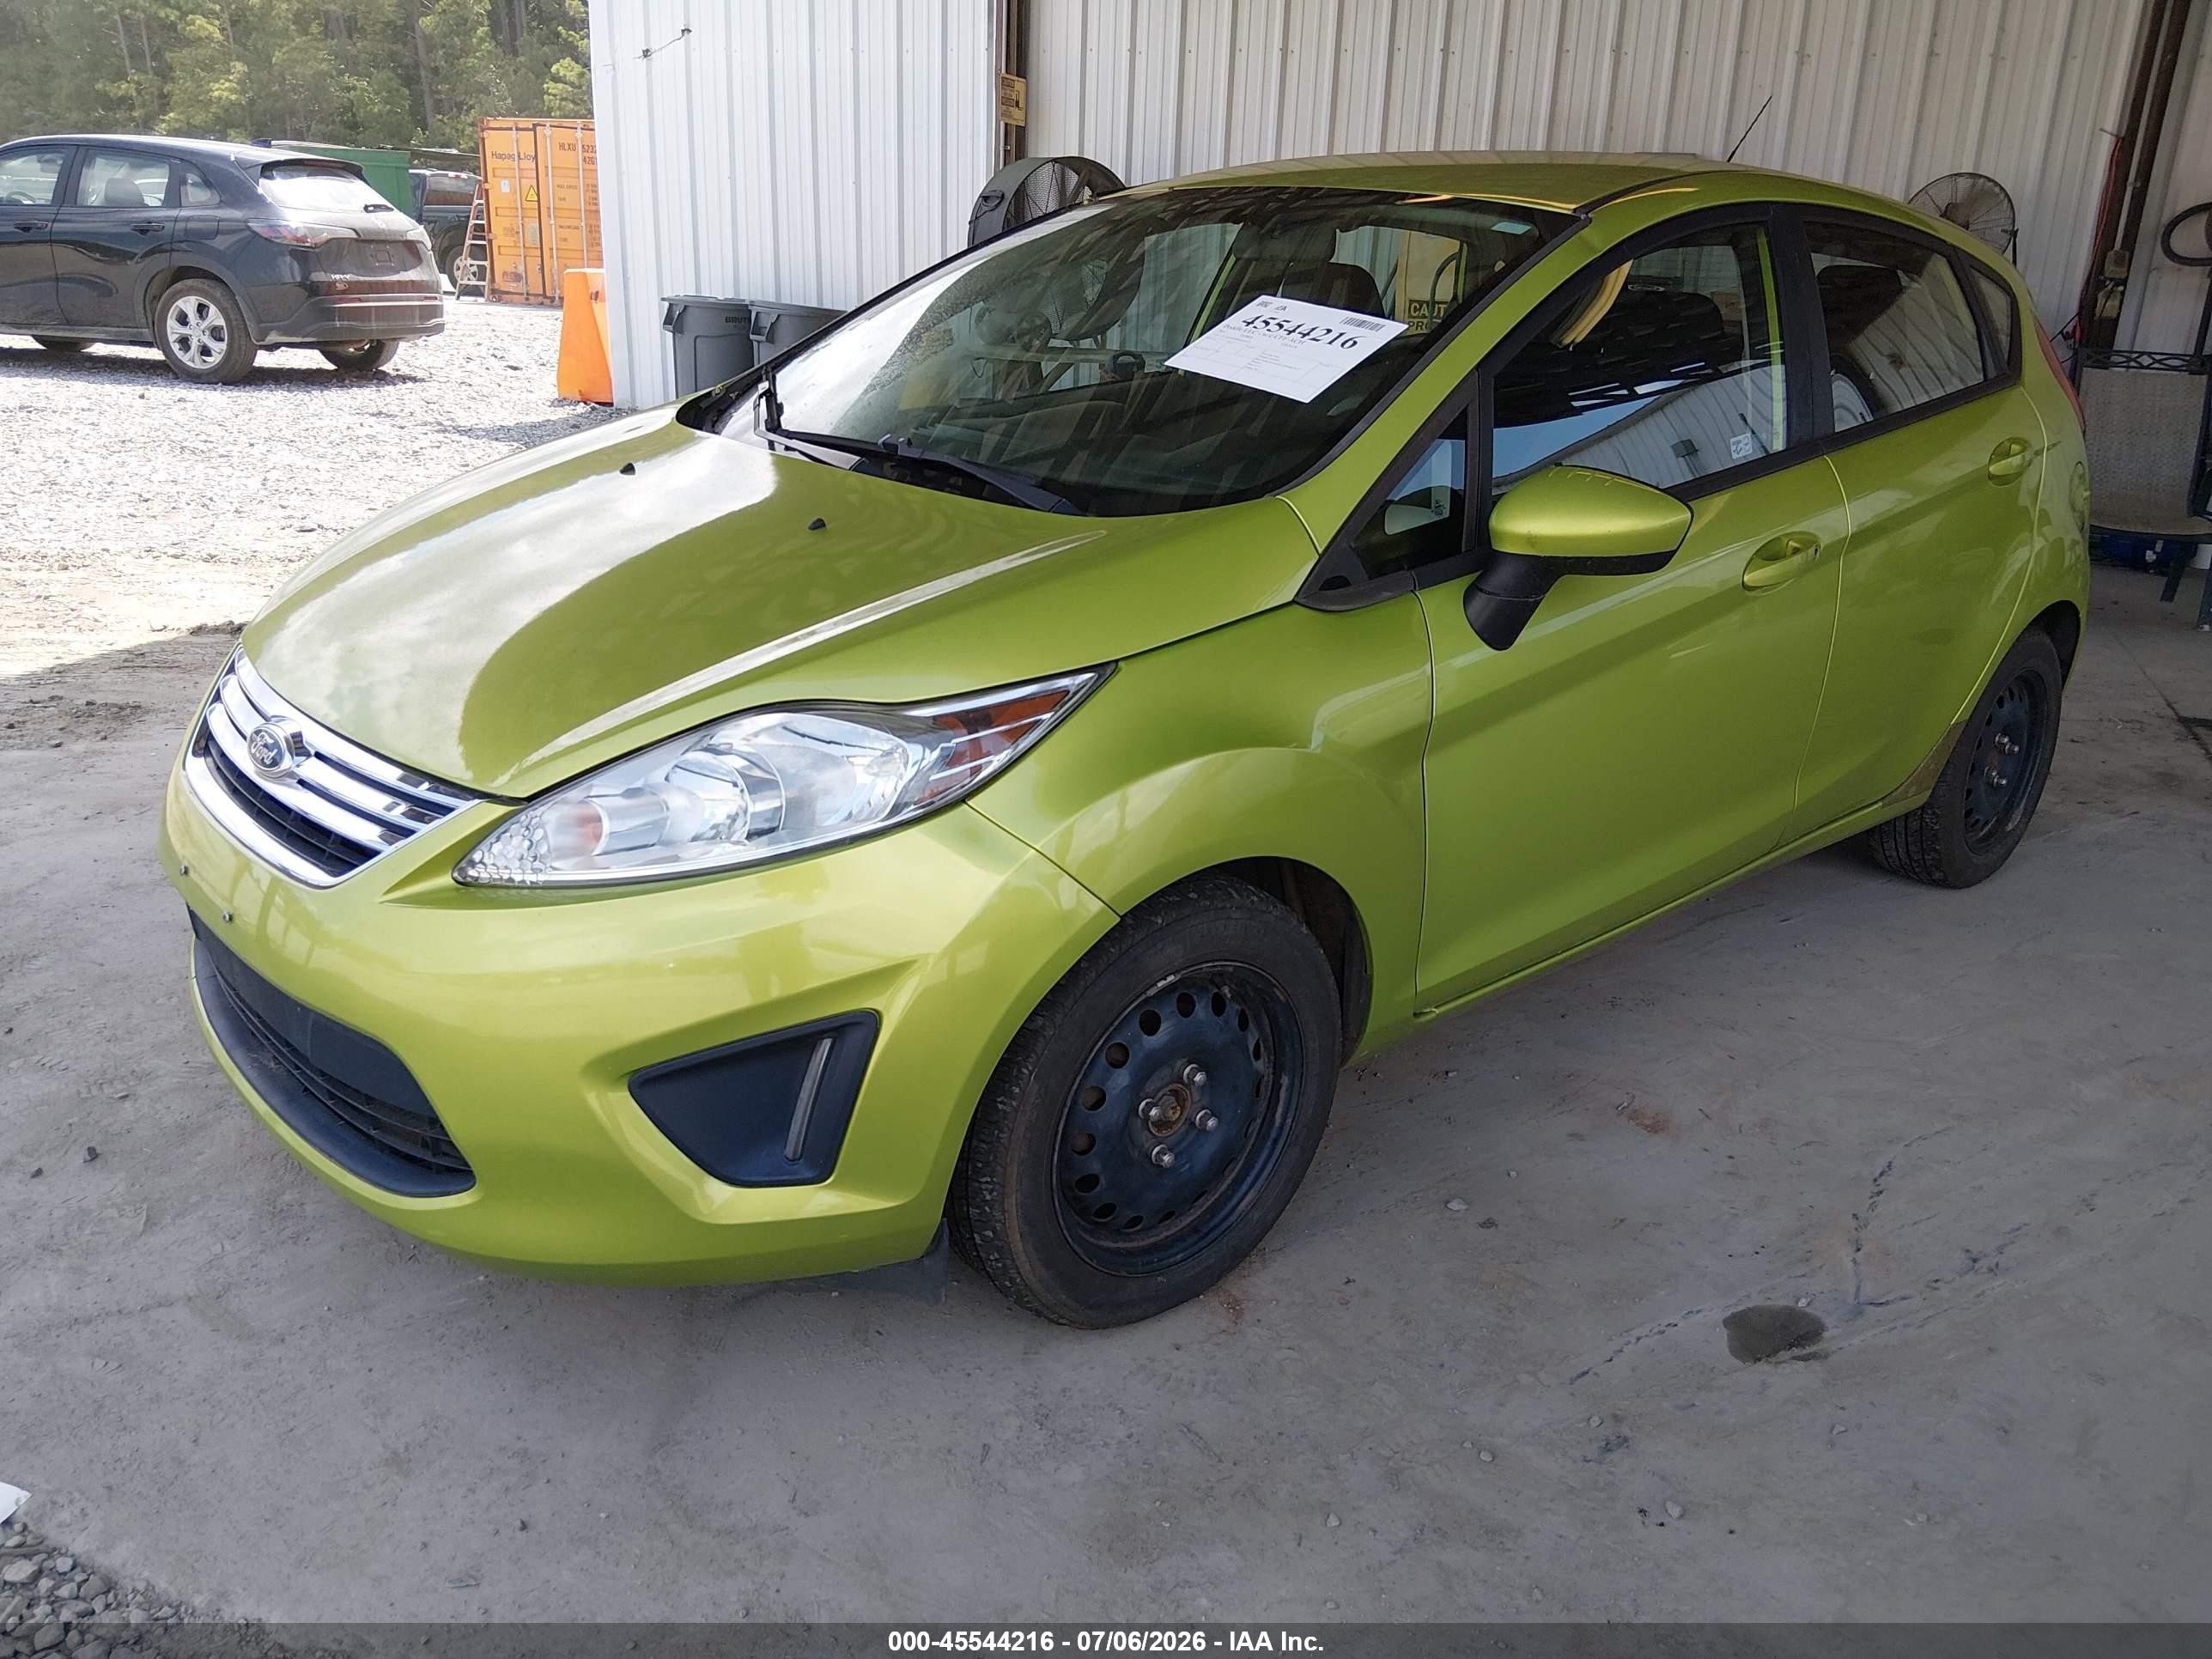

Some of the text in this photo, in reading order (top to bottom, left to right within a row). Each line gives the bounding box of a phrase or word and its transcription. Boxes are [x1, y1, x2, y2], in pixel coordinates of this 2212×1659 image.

[558, 142, 577, 152] HLXU
[1242, 314, 1367, 350] 45544216
[252, 732, 277, 764] Ford
